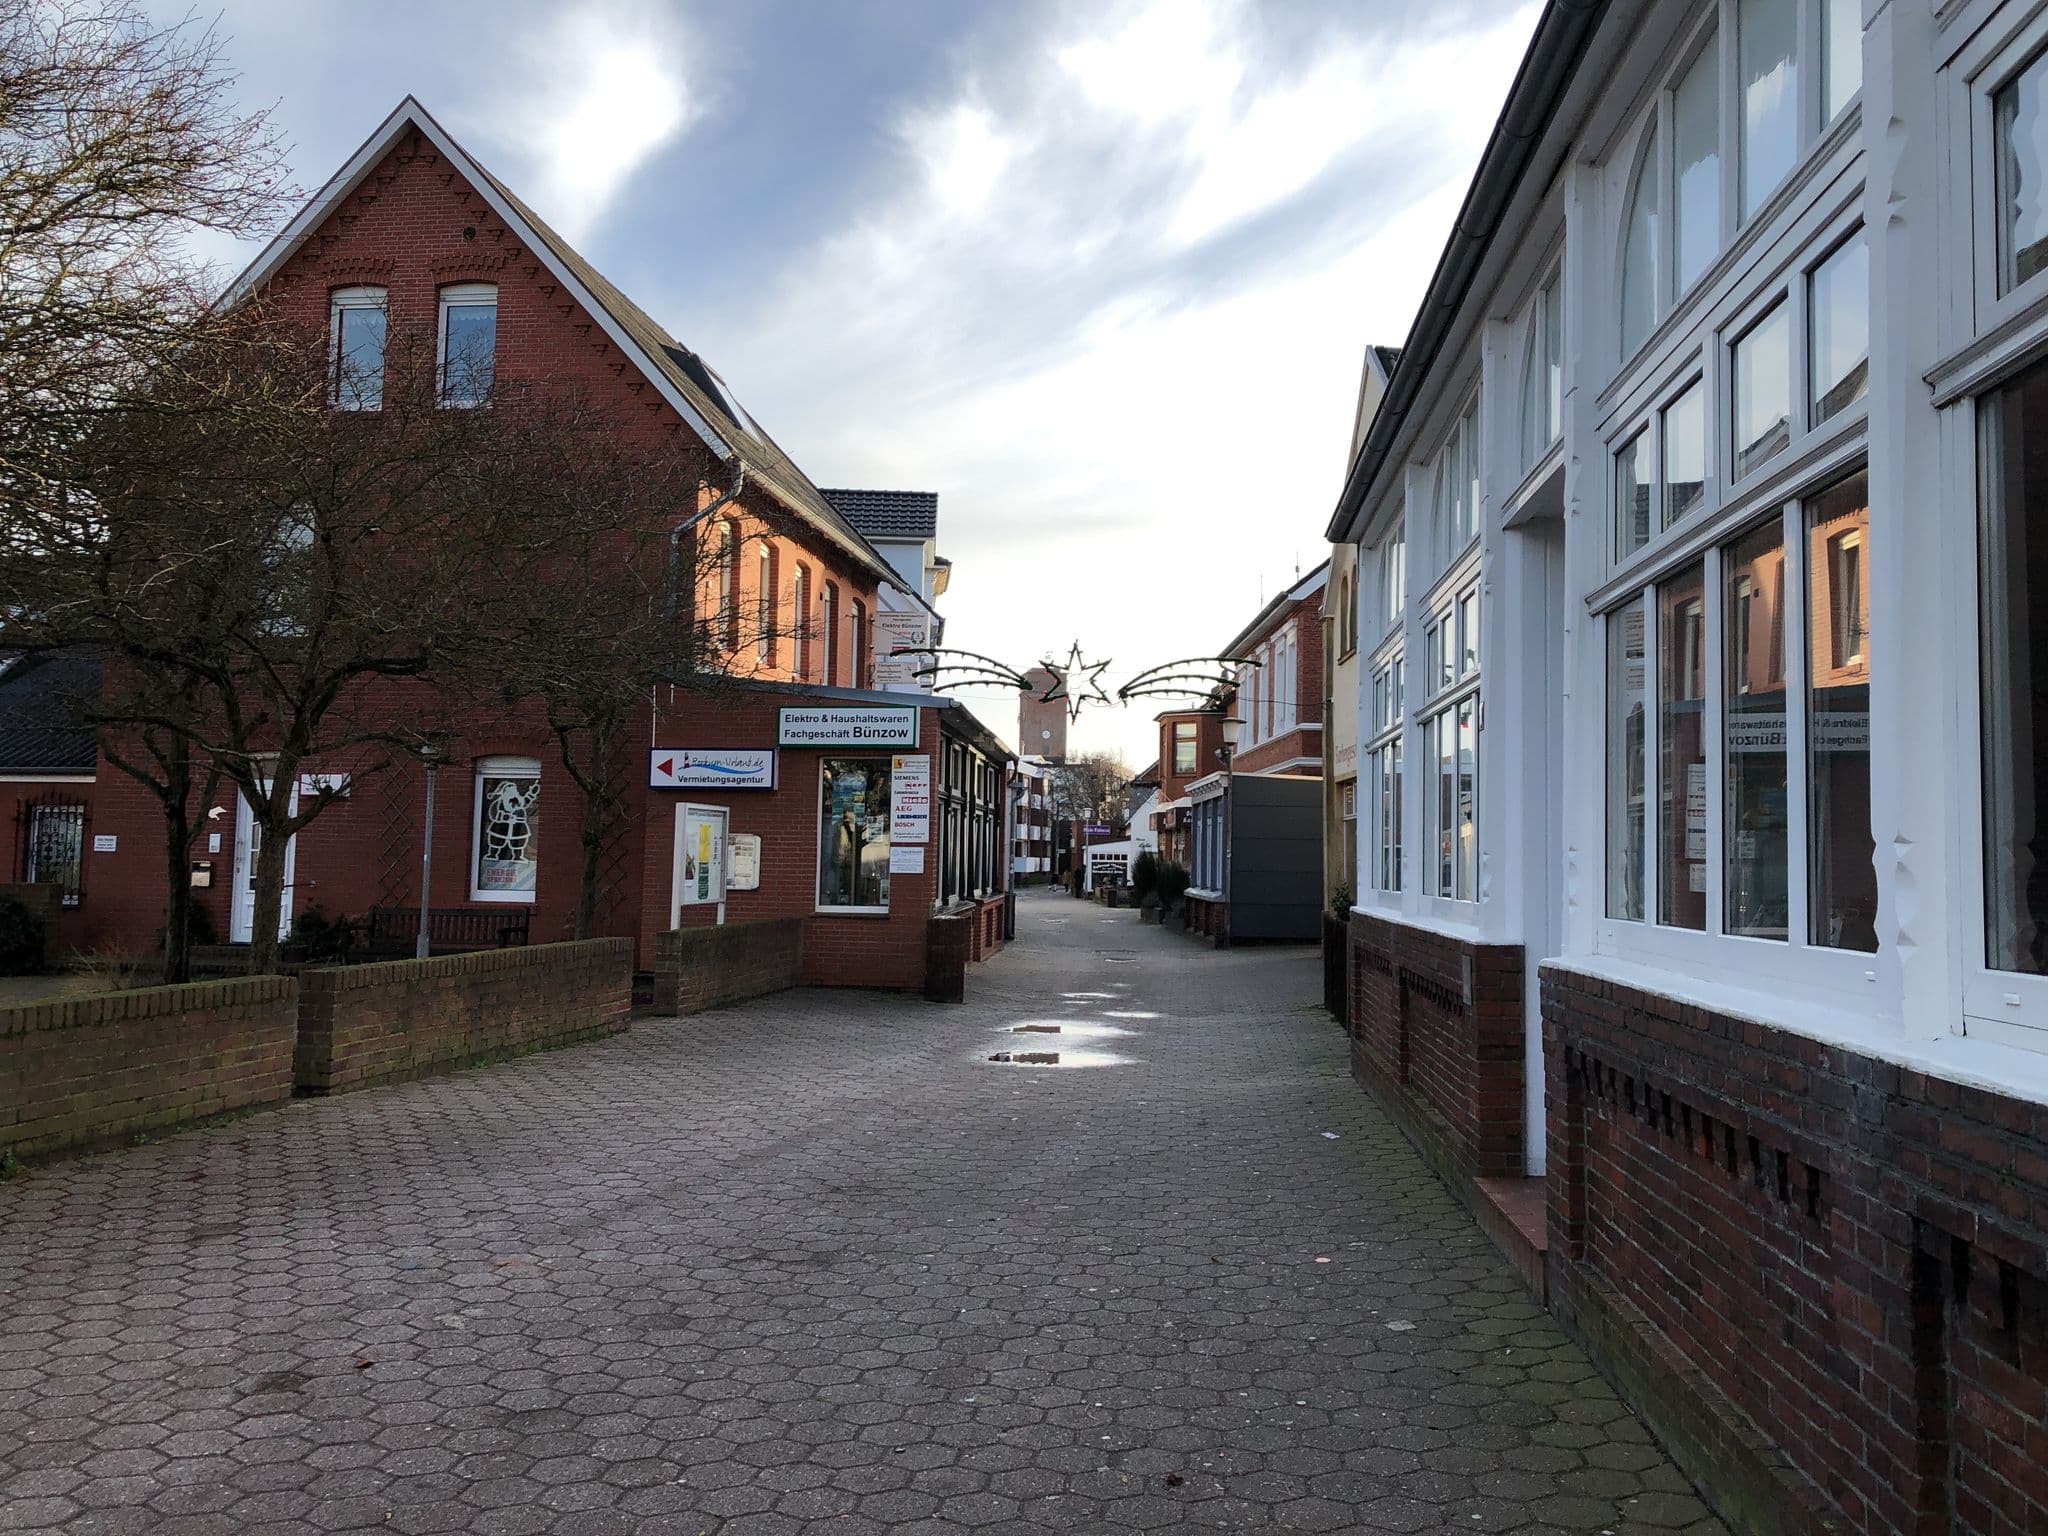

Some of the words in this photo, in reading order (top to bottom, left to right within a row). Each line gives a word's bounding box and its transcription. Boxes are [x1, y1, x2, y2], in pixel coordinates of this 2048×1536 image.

[785, 714, 819, 723] Elektro
[821, 714, 828, 723] &
[831, 714, 909, 723] Haushaltswaren
[784, 729, 850, 740] Fachgeschäft
[853, 726, 909, 738] Bünzow
[678, 775, 764, 785] Vermietungsagentur
